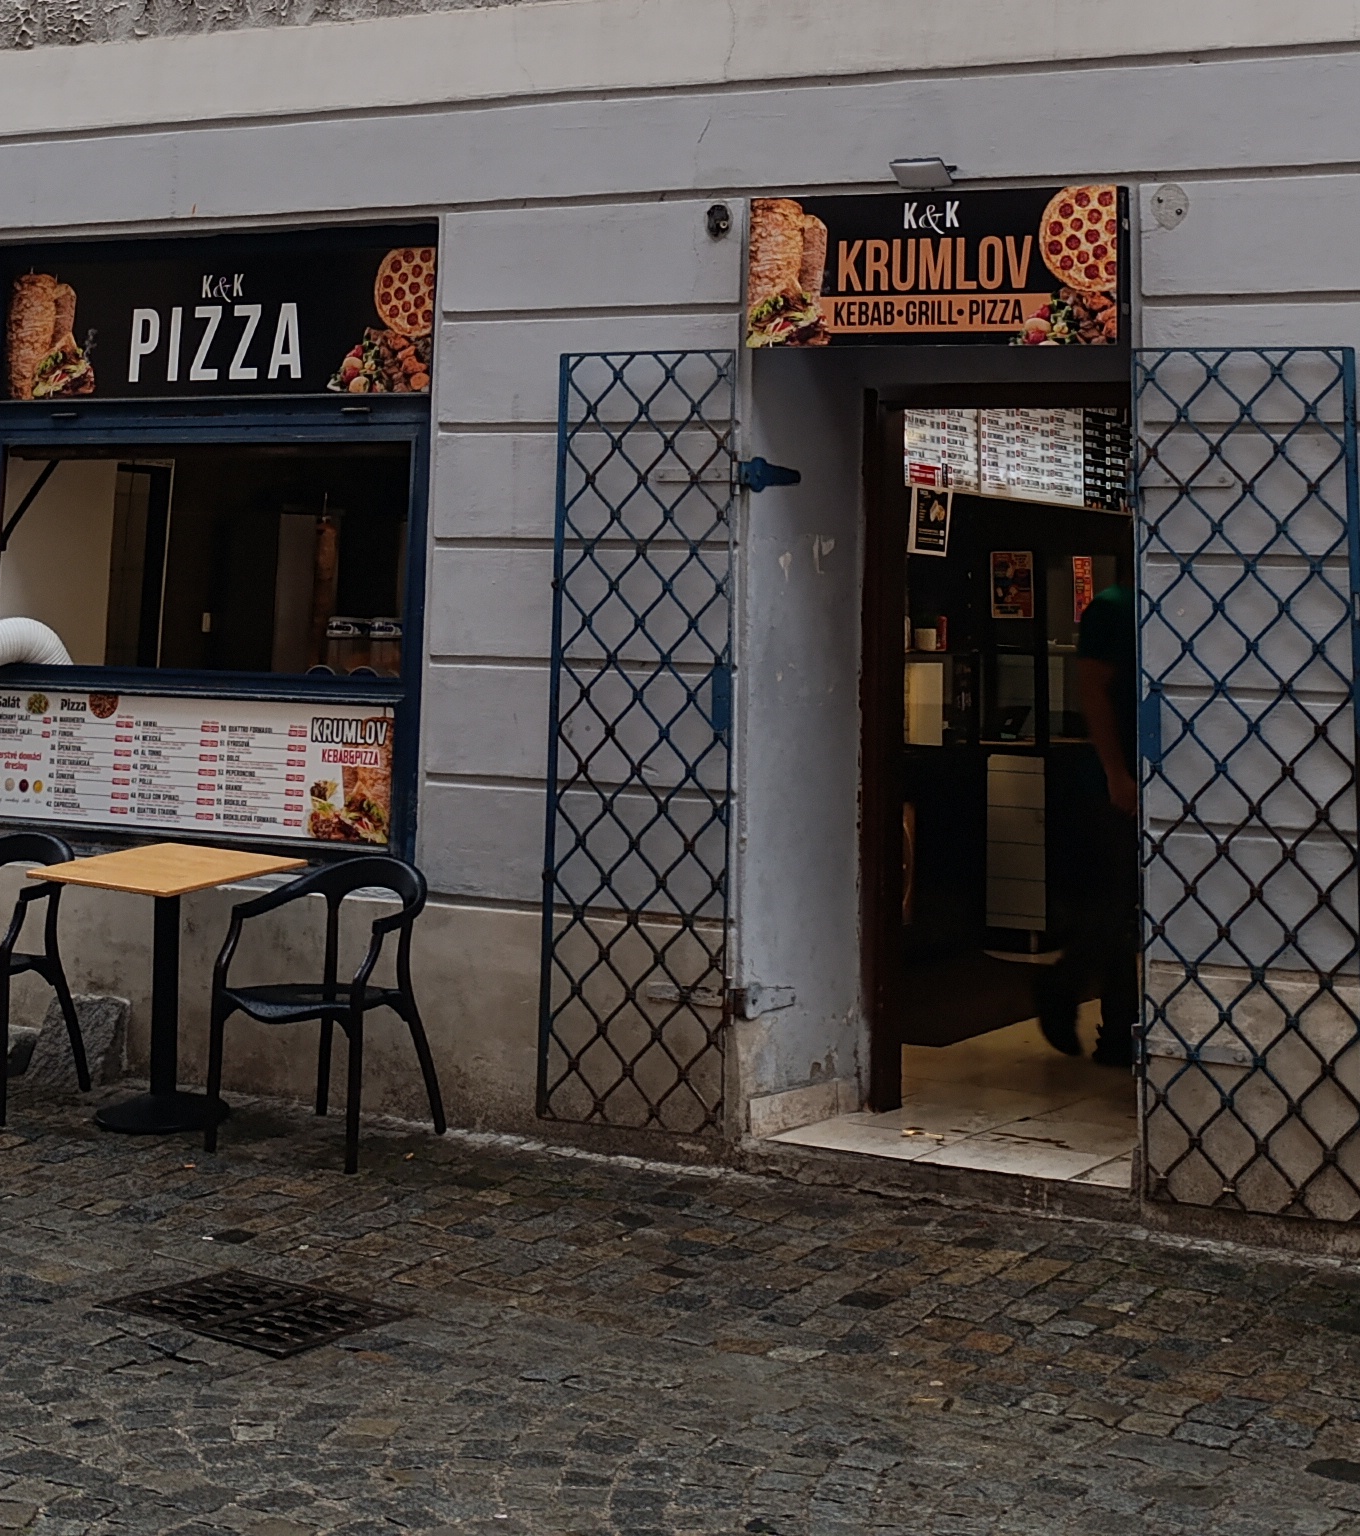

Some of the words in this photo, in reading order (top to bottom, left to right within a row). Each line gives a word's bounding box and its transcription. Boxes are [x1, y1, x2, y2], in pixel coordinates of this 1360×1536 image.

[903, 201, 960, 234] K&K
[837, 235, 1032, 292] KRUMLOV
[202, 274, 244, 302] K&K
[969, 299, 1023, 325] PIZZA
[129, 303, 302, 382] PIZZA
[61, 699, 86, 712] Pizza
[312, 718, 387, 745] KRUMLOV
